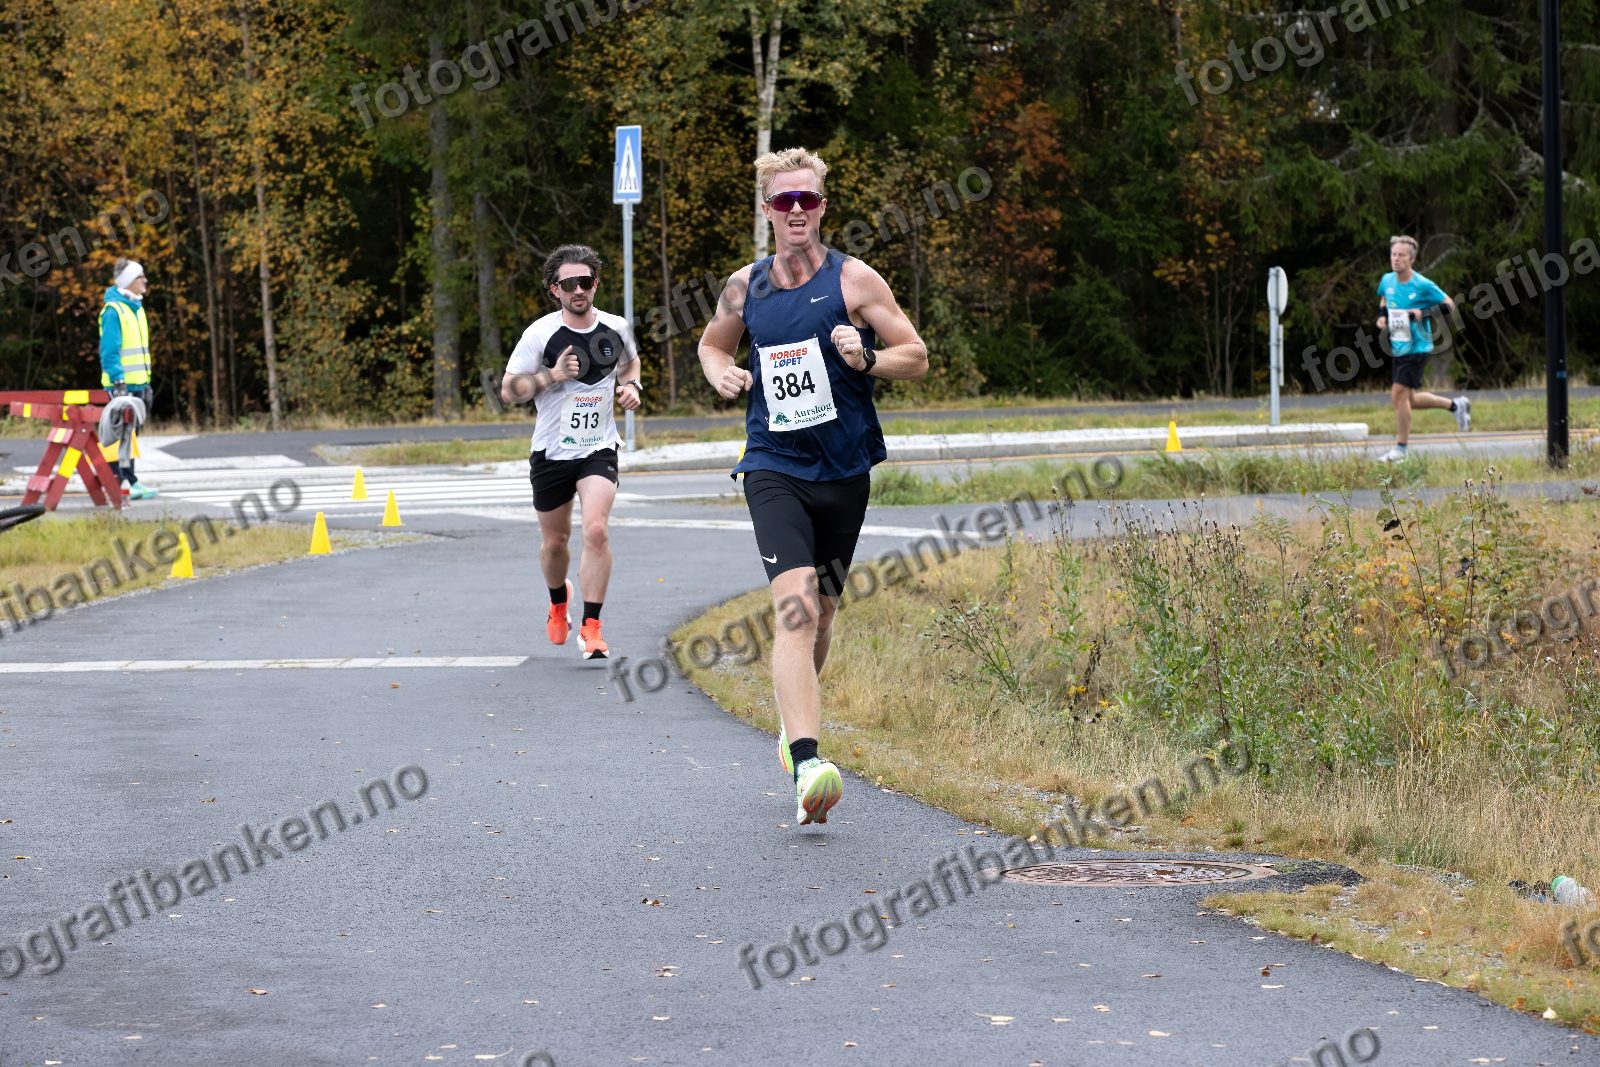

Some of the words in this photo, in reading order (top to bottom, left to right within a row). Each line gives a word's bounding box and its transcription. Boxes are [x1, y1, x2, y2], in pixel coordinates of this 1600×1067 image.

[769, 347, 808, 361] NORGES
[773, 357, 803, 369] LØPET
[772, 370, 816, 401] 384
[793, 402, 833, 419] Aurskog
[570, 412, 600, 430] 513
